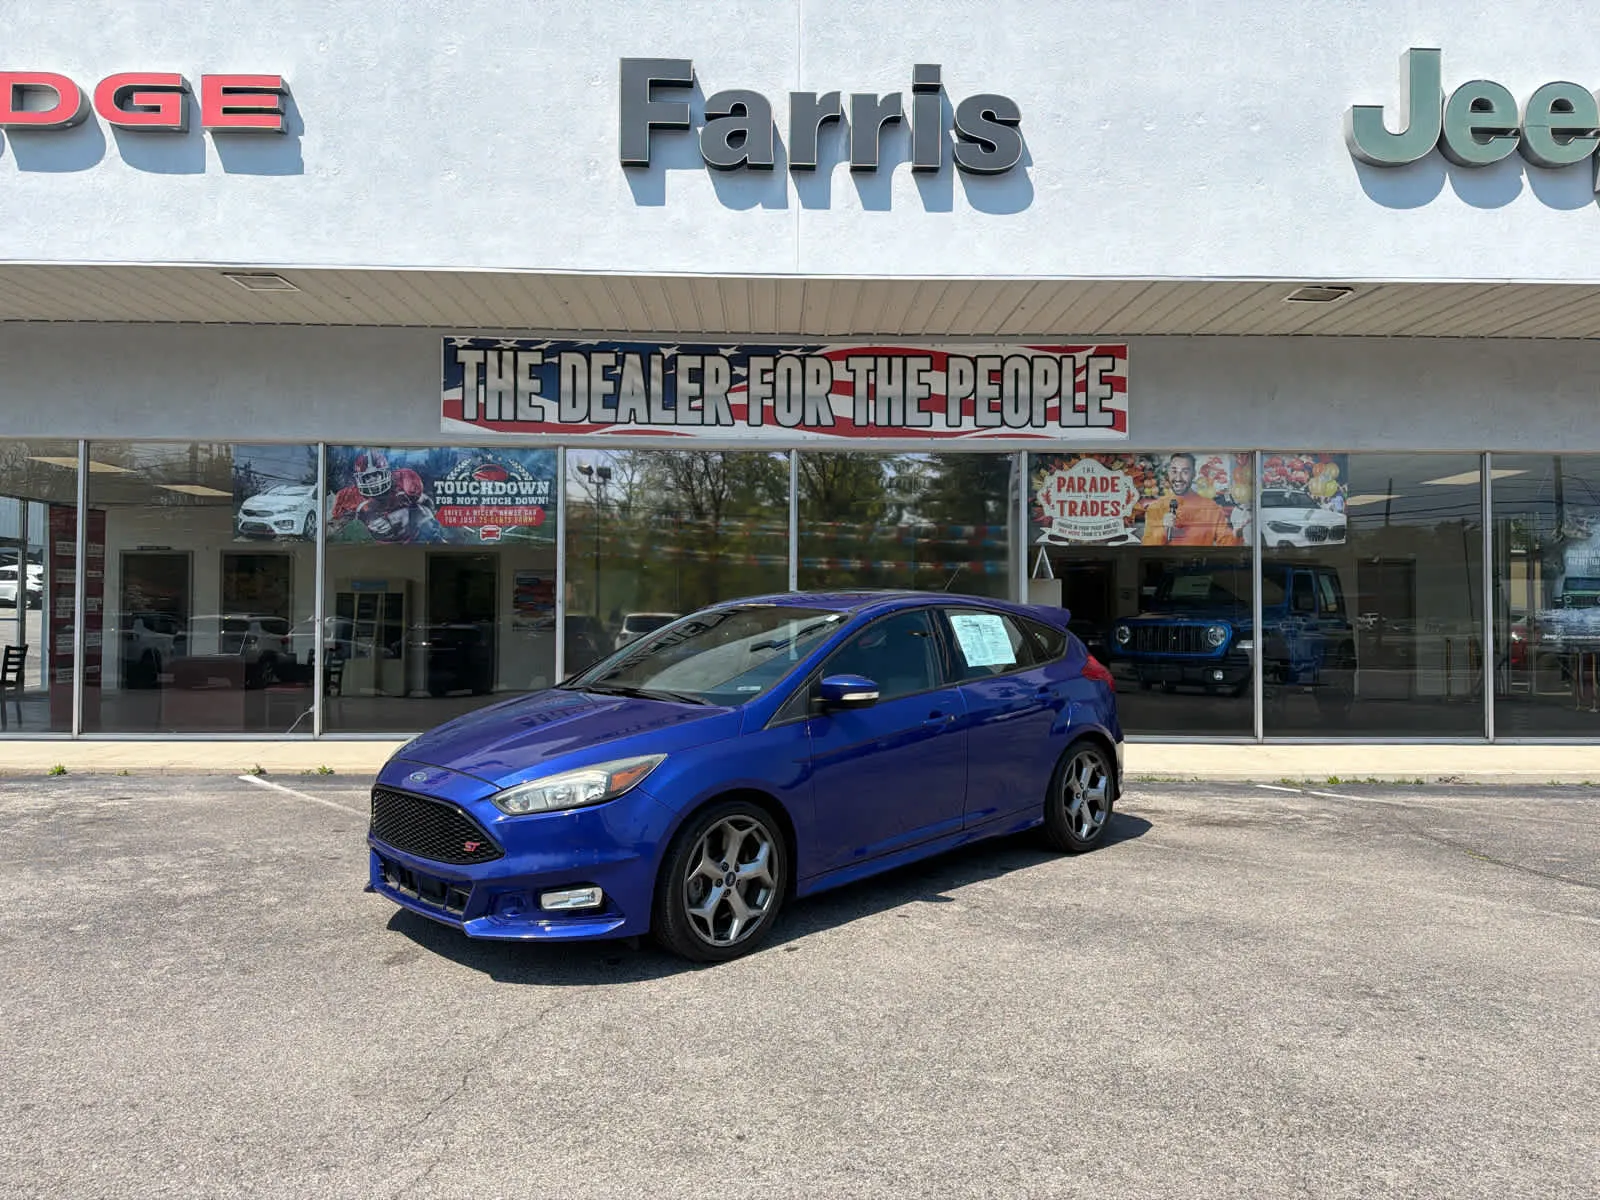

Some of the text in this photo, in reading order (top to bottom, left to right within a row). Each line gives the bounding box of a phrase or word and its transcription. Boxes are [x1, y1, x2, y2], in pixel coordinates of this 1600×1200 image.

[618, 57, 1022, 175] Farris
[1345, 48, 1600, 192] Jee
[456, 349, 1116, 429] THE DEALER FOR THE PEOPLE
[433, 480, 550, 495] TOUCHDOWN
[1056, 476, 1121, 493] PARADE
[435, 496, 549, 505] FOR NOT MUCH DOWN!
[1056, 500, 1121, 517] TRADES
[463, 841, 481, 852] ST
